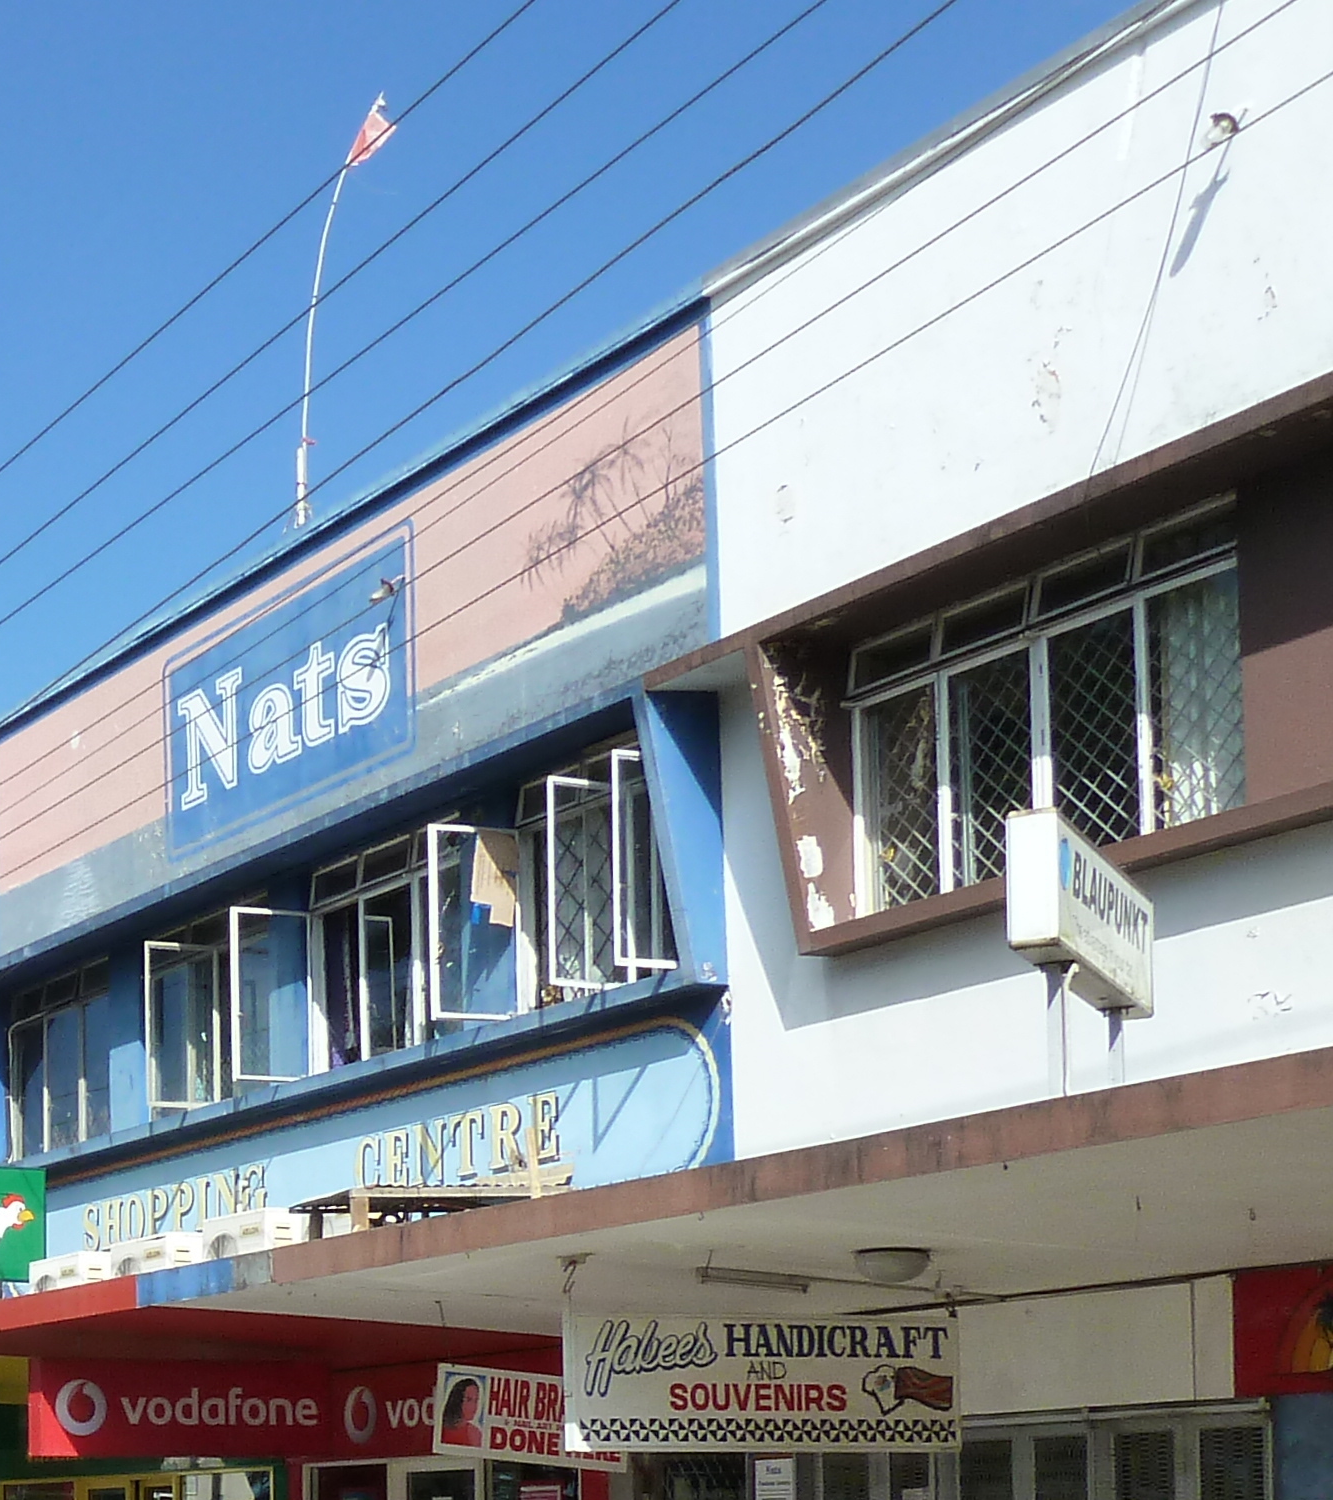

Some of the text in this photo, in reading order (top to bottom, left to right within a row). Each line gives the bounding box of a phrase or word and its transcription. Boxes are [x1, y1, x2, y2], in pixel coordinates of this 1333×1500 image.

[178, 622, 391, 811] Nats
[1072, 850, 1149, 954] BLAUPUNKT
[83, 1094, 561, 1251] SHOPPING CENTRE
[724, 1323, 948, 1360] HANDICRAFT
[747, 1361, 787, 1381] AND
[120, 1387, 318, 1426] vodafone
[488, 1376, 531, 1419] HAIR
[669, 1383, 847, 1412] SOUVENIRS
[490, 1426, 561, 1456] DONE
